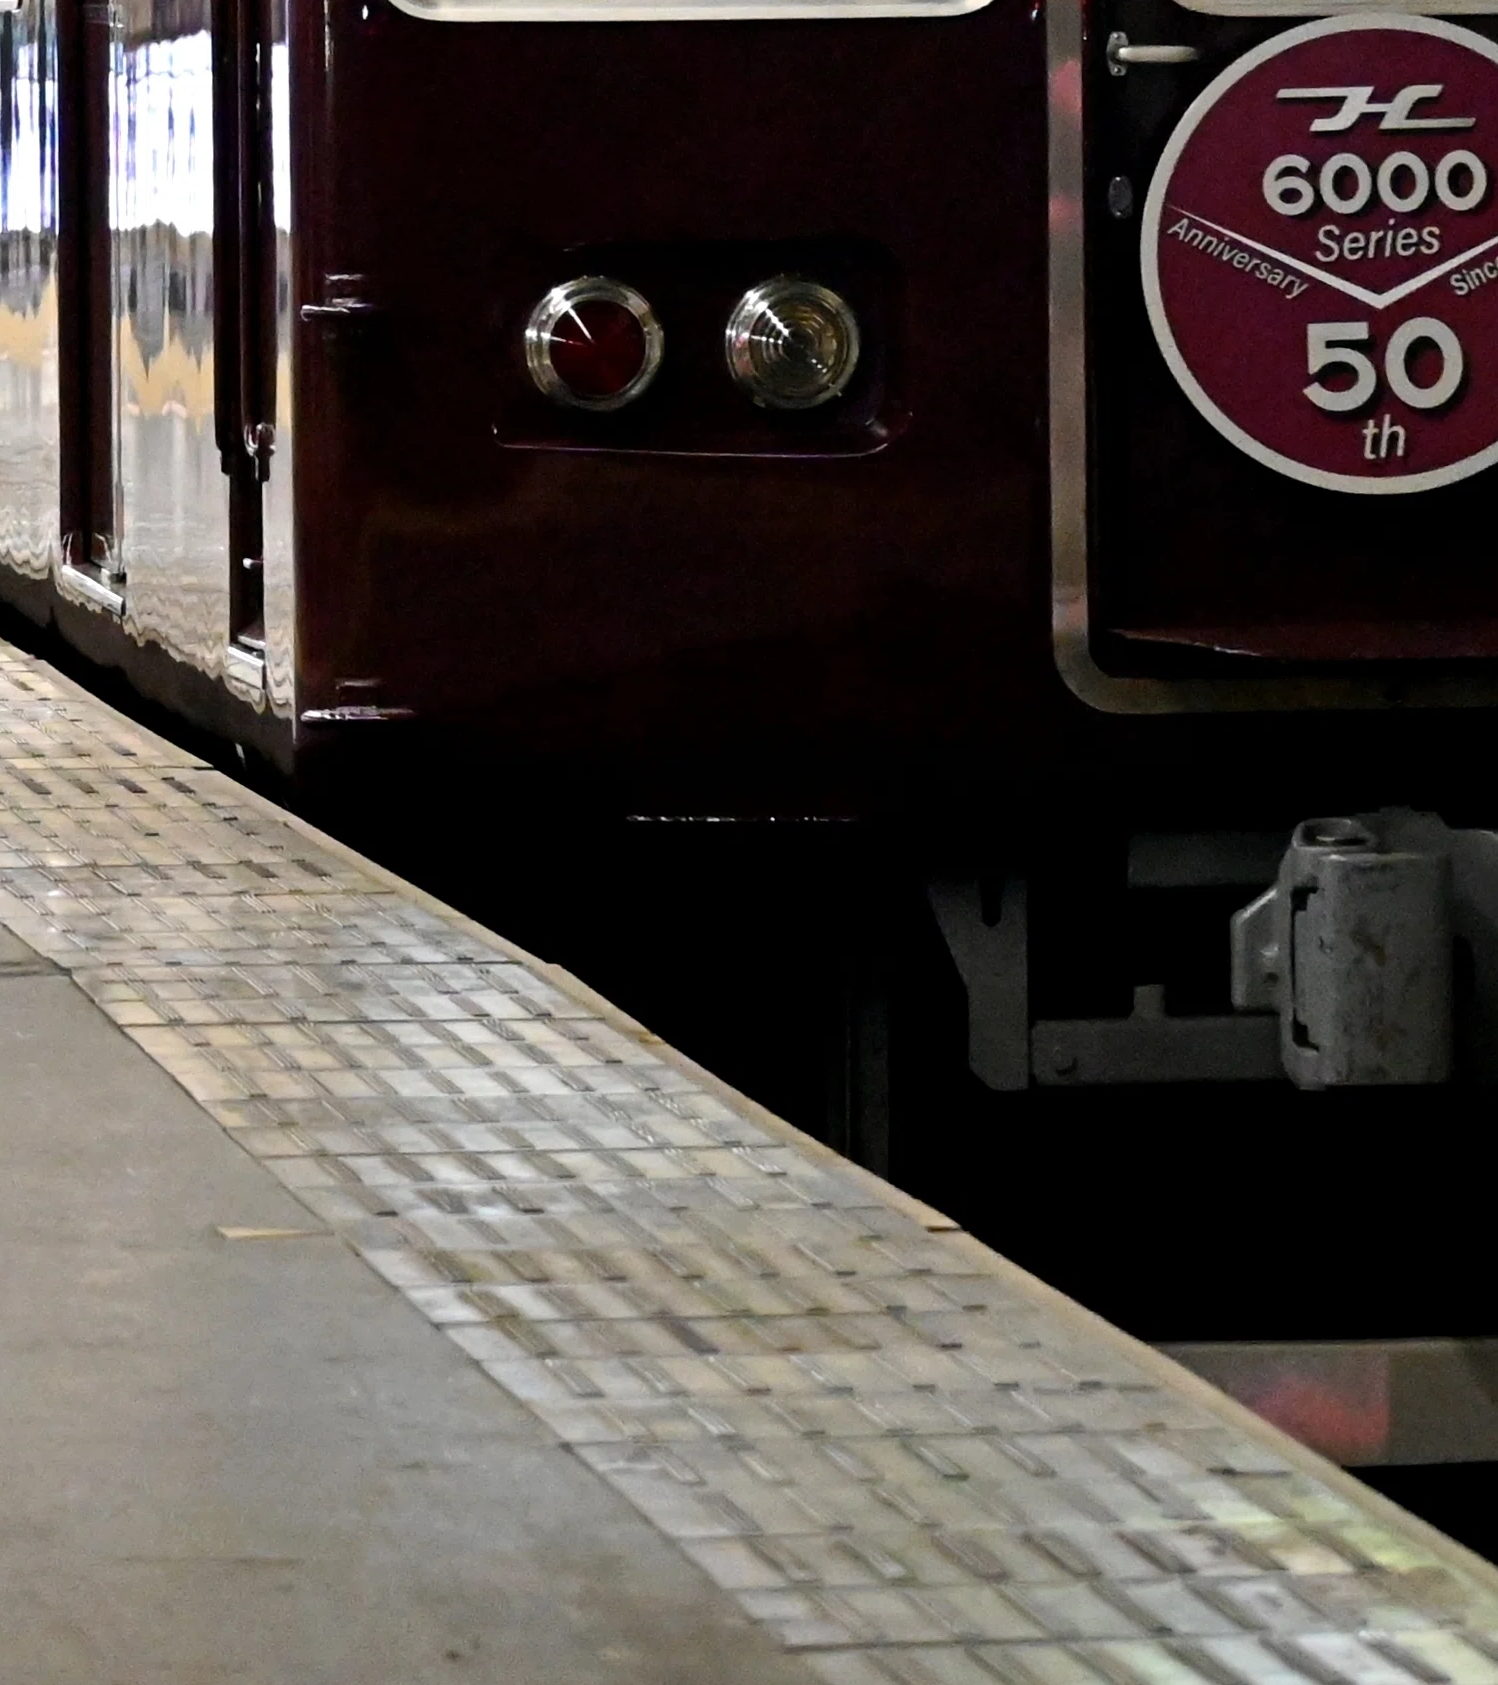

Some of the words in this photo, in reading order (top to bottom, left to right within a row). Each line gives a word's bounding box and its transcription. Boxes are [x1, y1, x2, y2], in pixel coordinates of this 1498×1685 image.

[1262, 150, 1487, 216] 6000
[1167, 217, 1310, 300] Anniversary
[1315, 219, 1442, 263] Series
[1303, 316, 1464, 412] 50
[1362, 413, 1406, 461] th
